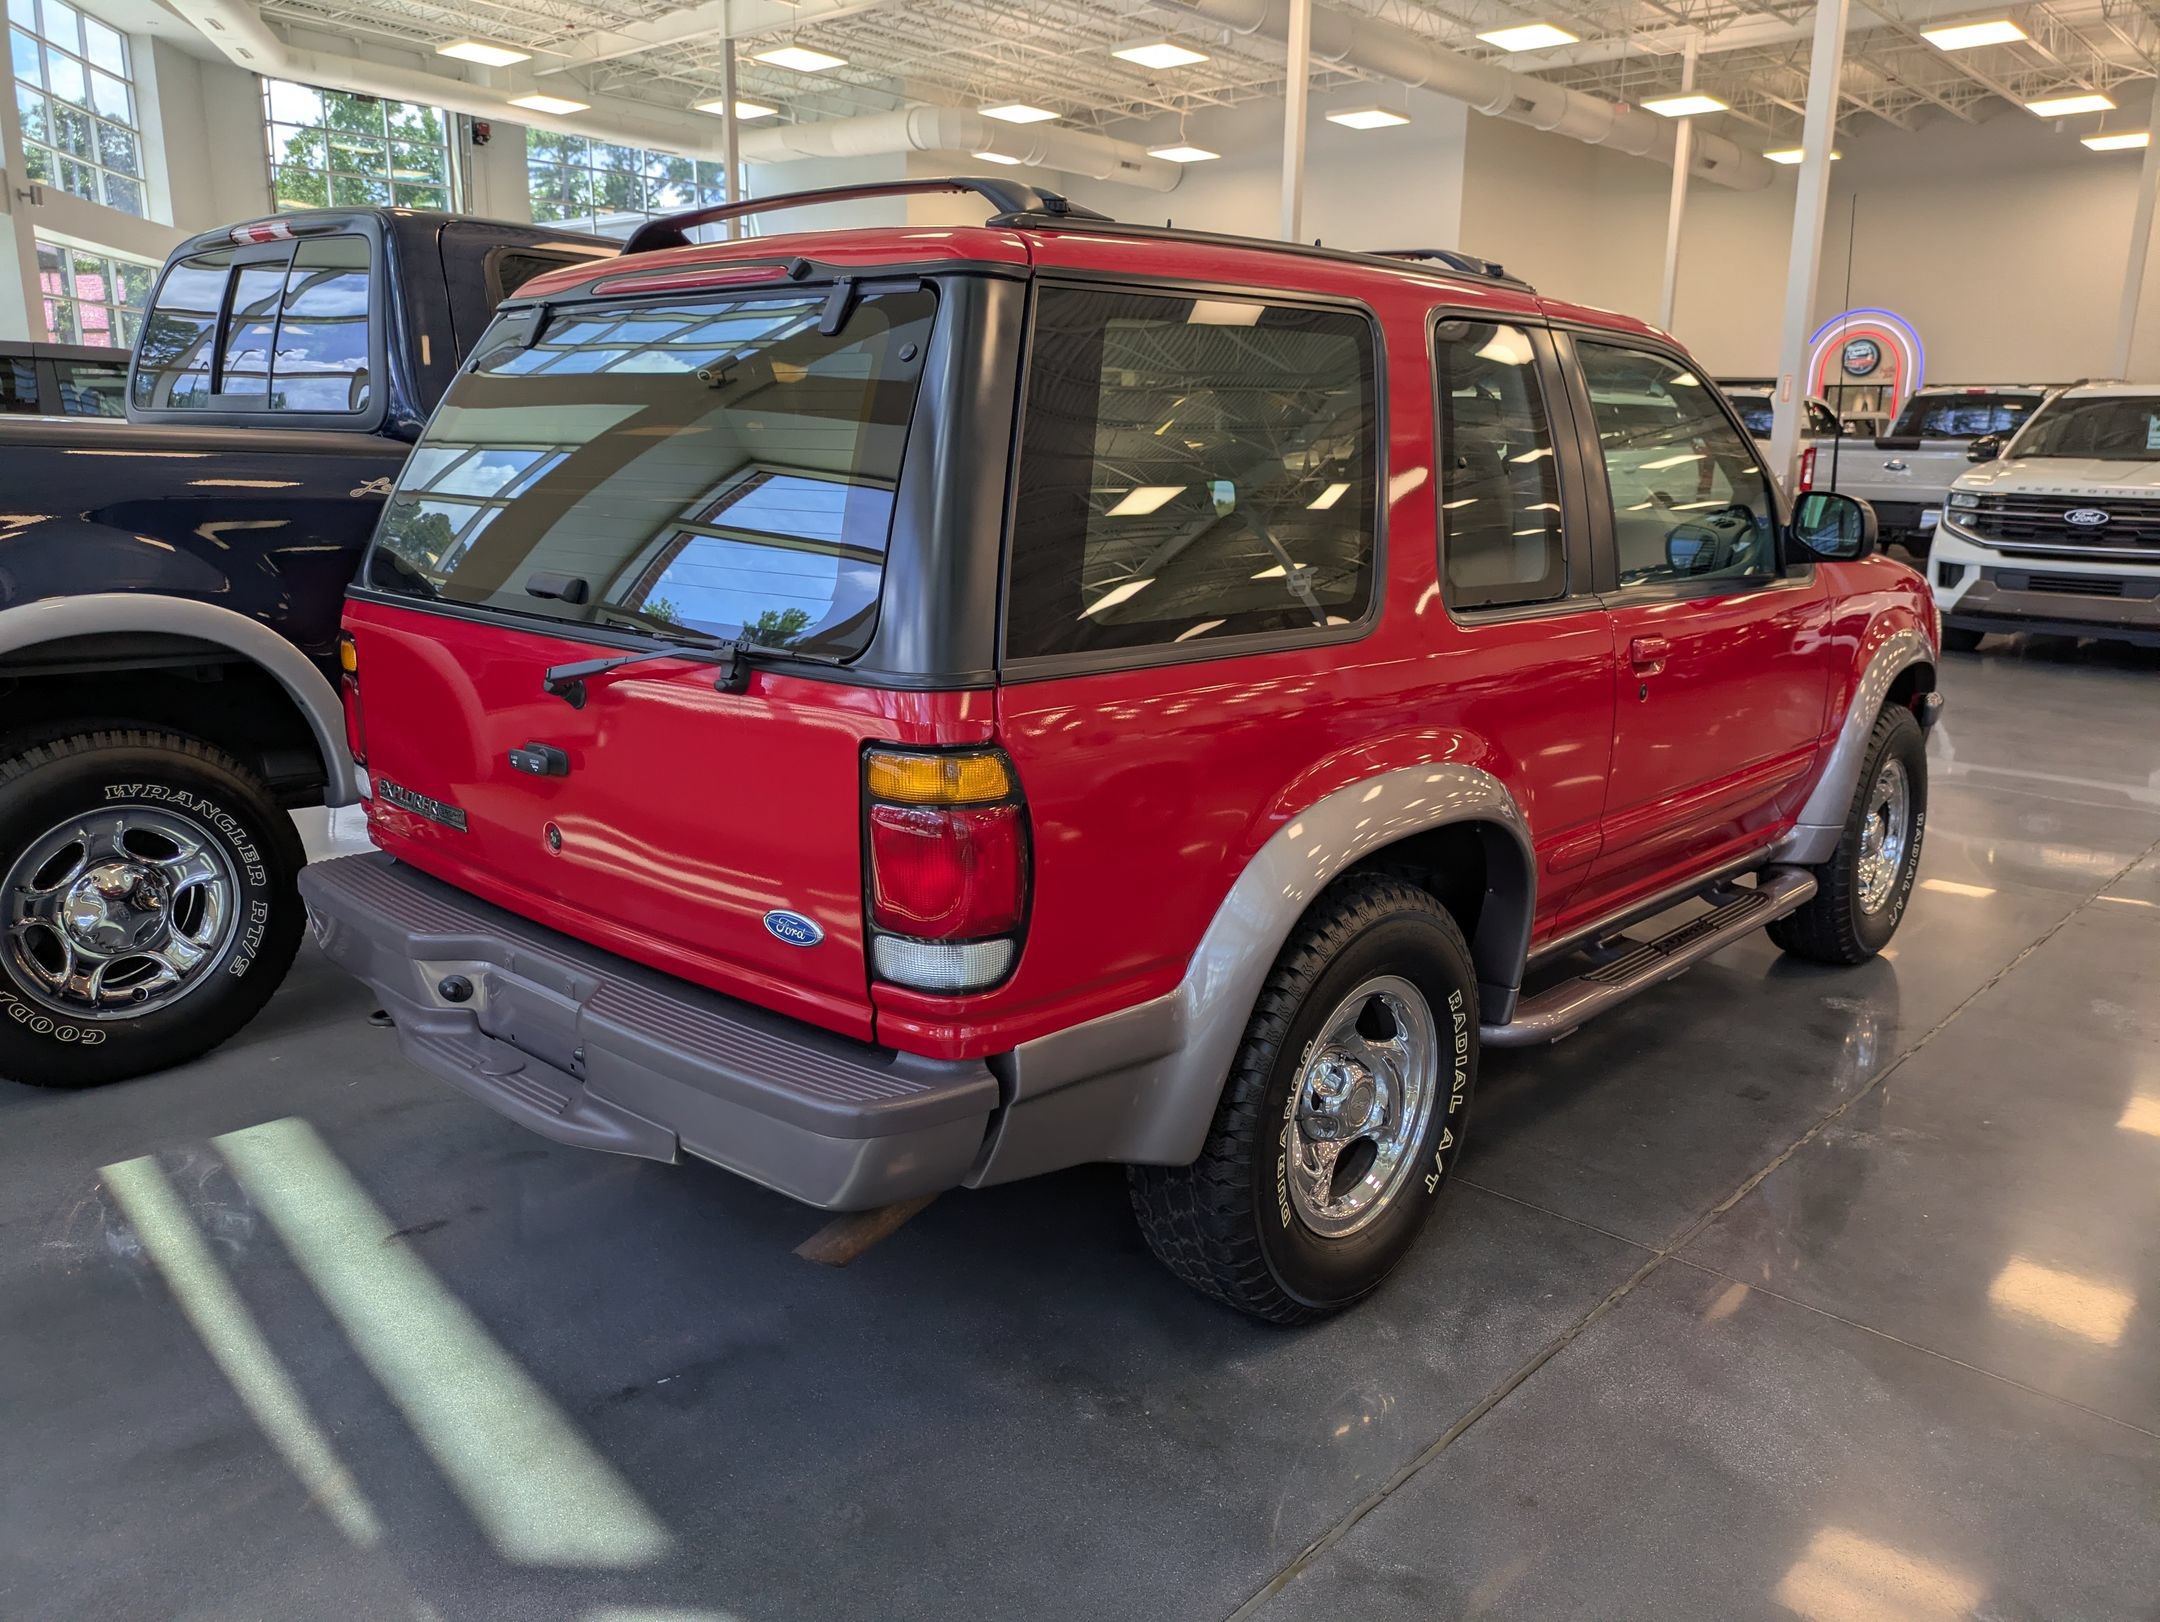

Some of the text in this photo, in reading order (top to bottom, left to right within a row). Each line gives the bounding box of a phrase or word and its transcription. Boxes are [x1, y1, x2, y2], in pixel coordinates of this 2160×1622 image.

[104, 783, 269, 977] WRANGLER RT/S
[379, 778, 439, 816] EXPLORER
[775, 917, 807, 940] Ford
[1276, 1039, 1314, 1229] DURANGO
[1423, 988, 1469, 1195] RADIAL A/T
